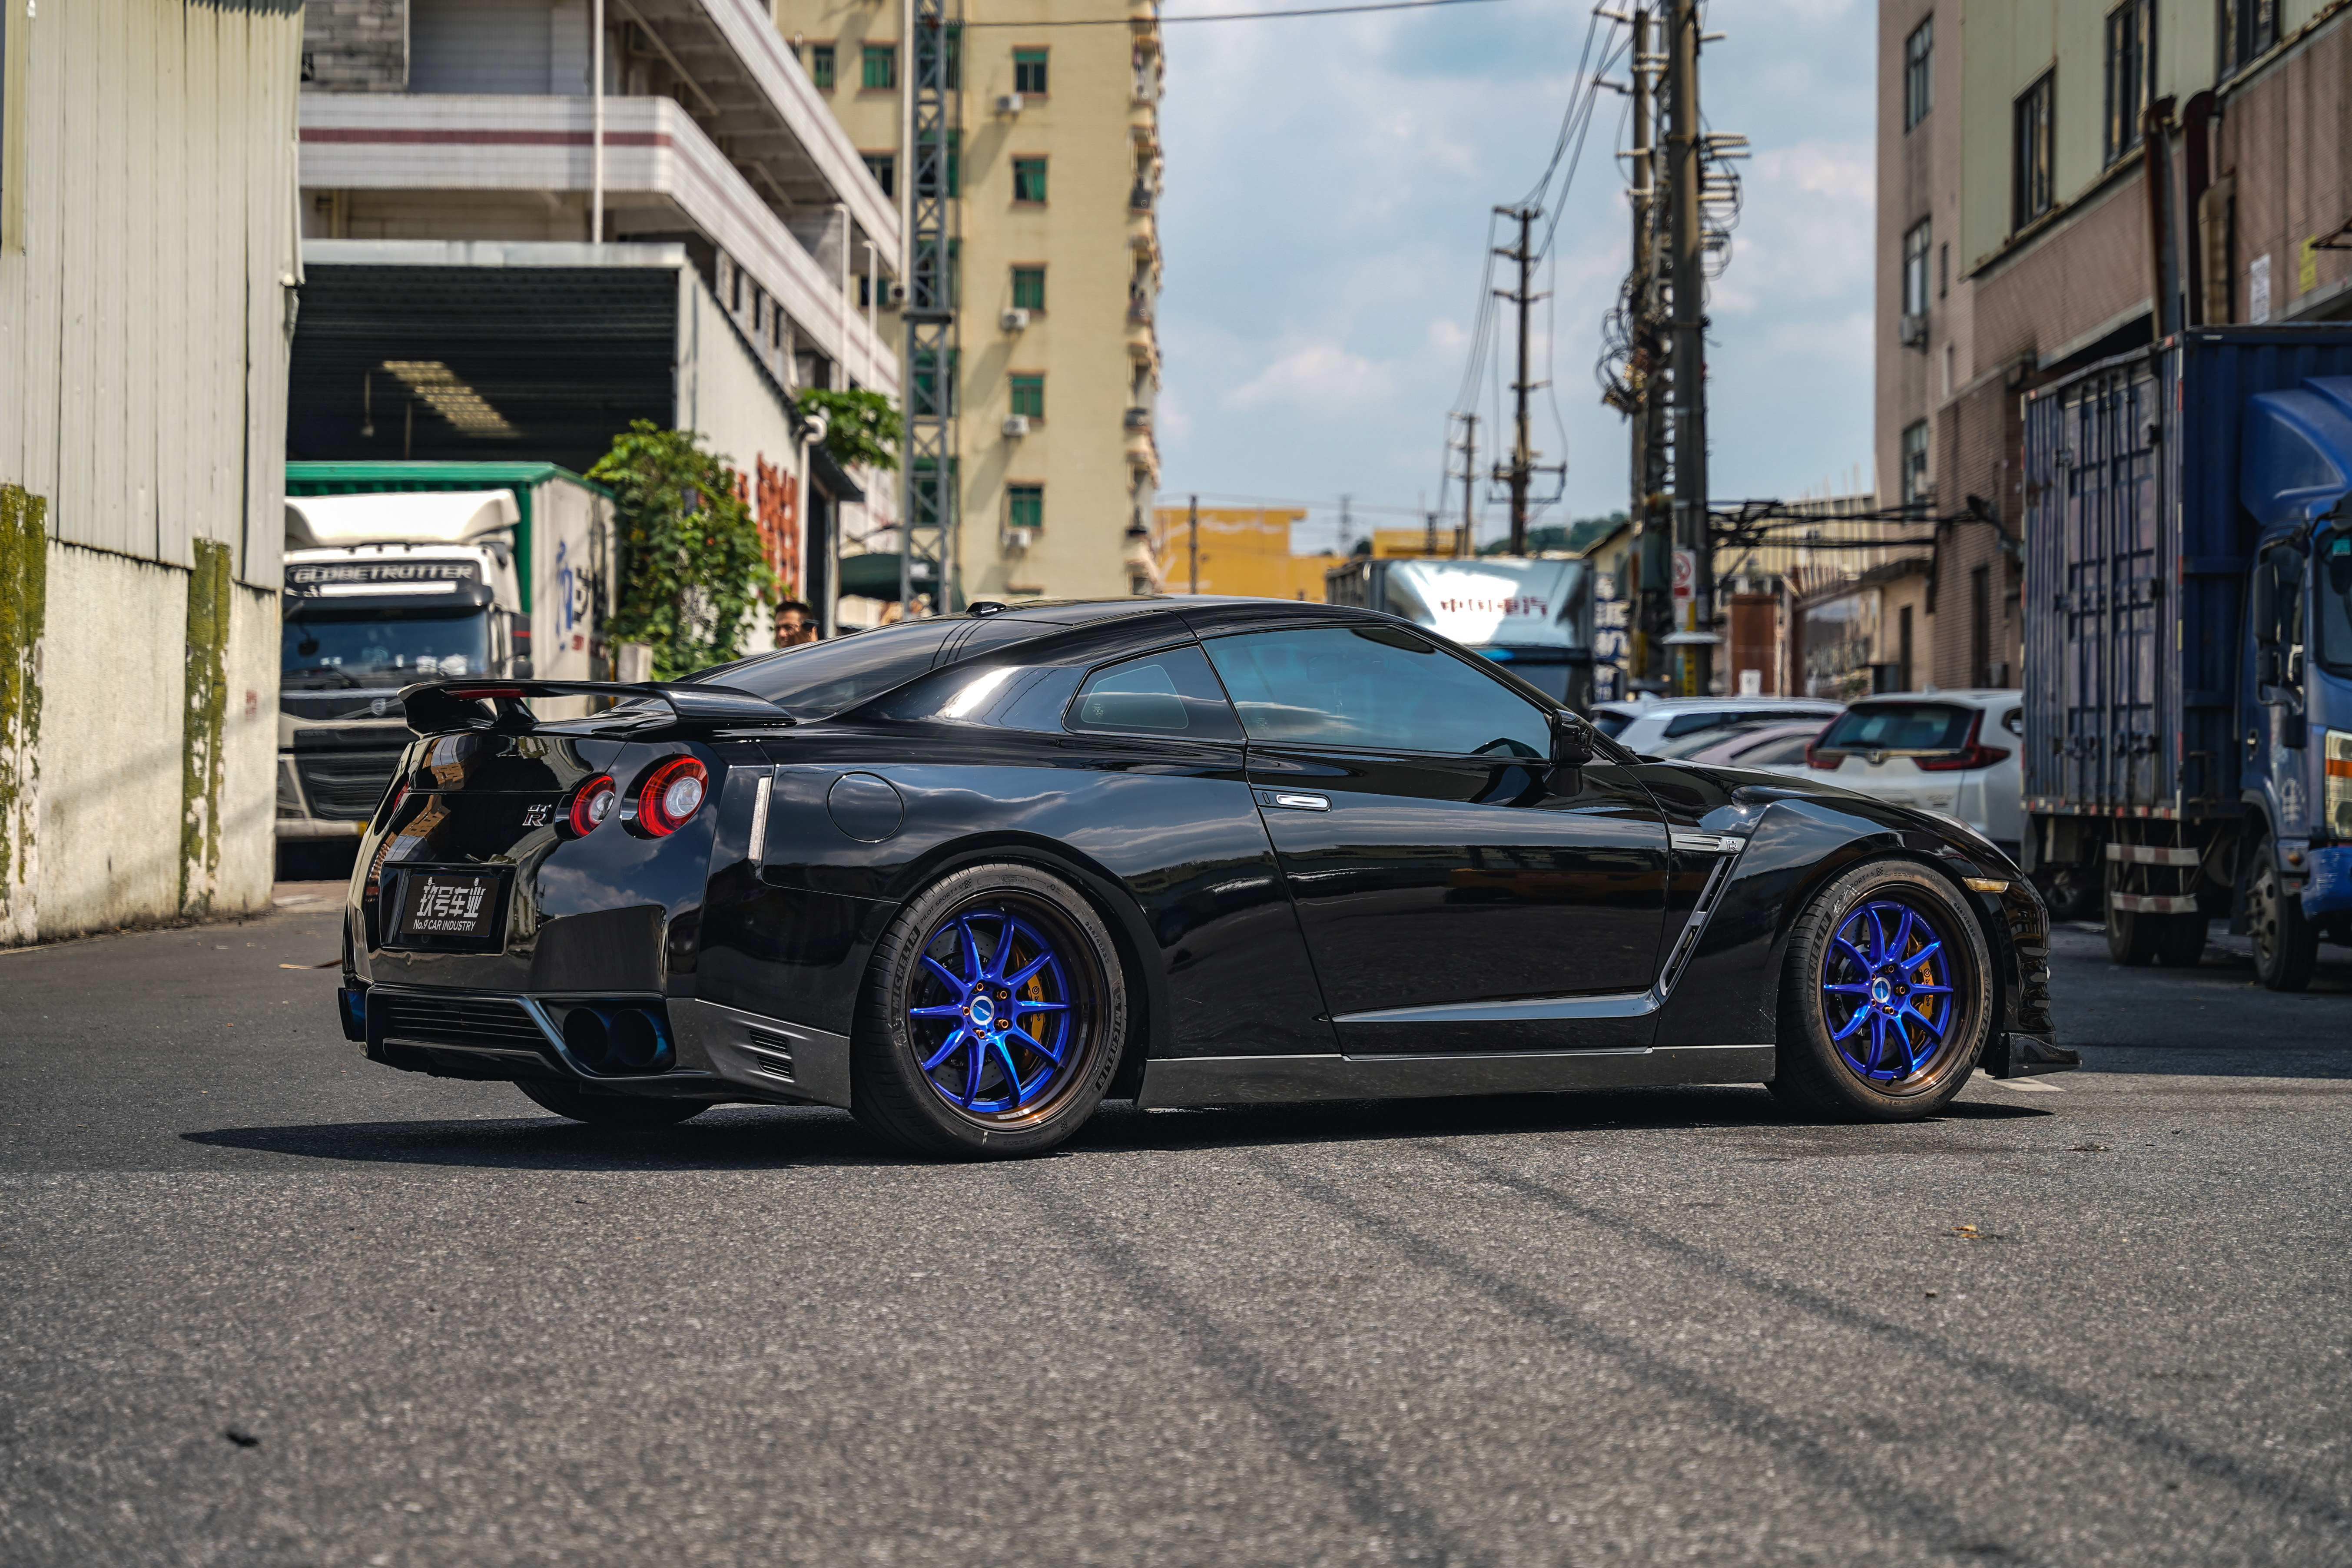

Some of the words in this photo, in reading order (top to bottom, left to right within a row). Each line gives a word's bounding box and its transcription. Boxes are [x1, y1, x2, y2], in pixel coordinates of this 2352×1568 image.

[413, 919, 429, 929] No.9
[428, 920, 442, 930] CAR
[441, 920, 476, 931] INDUSTRY
[416, 885, 487, 918] 玖号车业
[920, 906, 934, 924] PILOT
[935, 889, 954, 907] SPORT
[892, 929, 918, 1009] MICHELIN
[1808, 916, 1830, 1004] MICHELIN
[1098, 1009, 1121, 1086] MICHELIN
